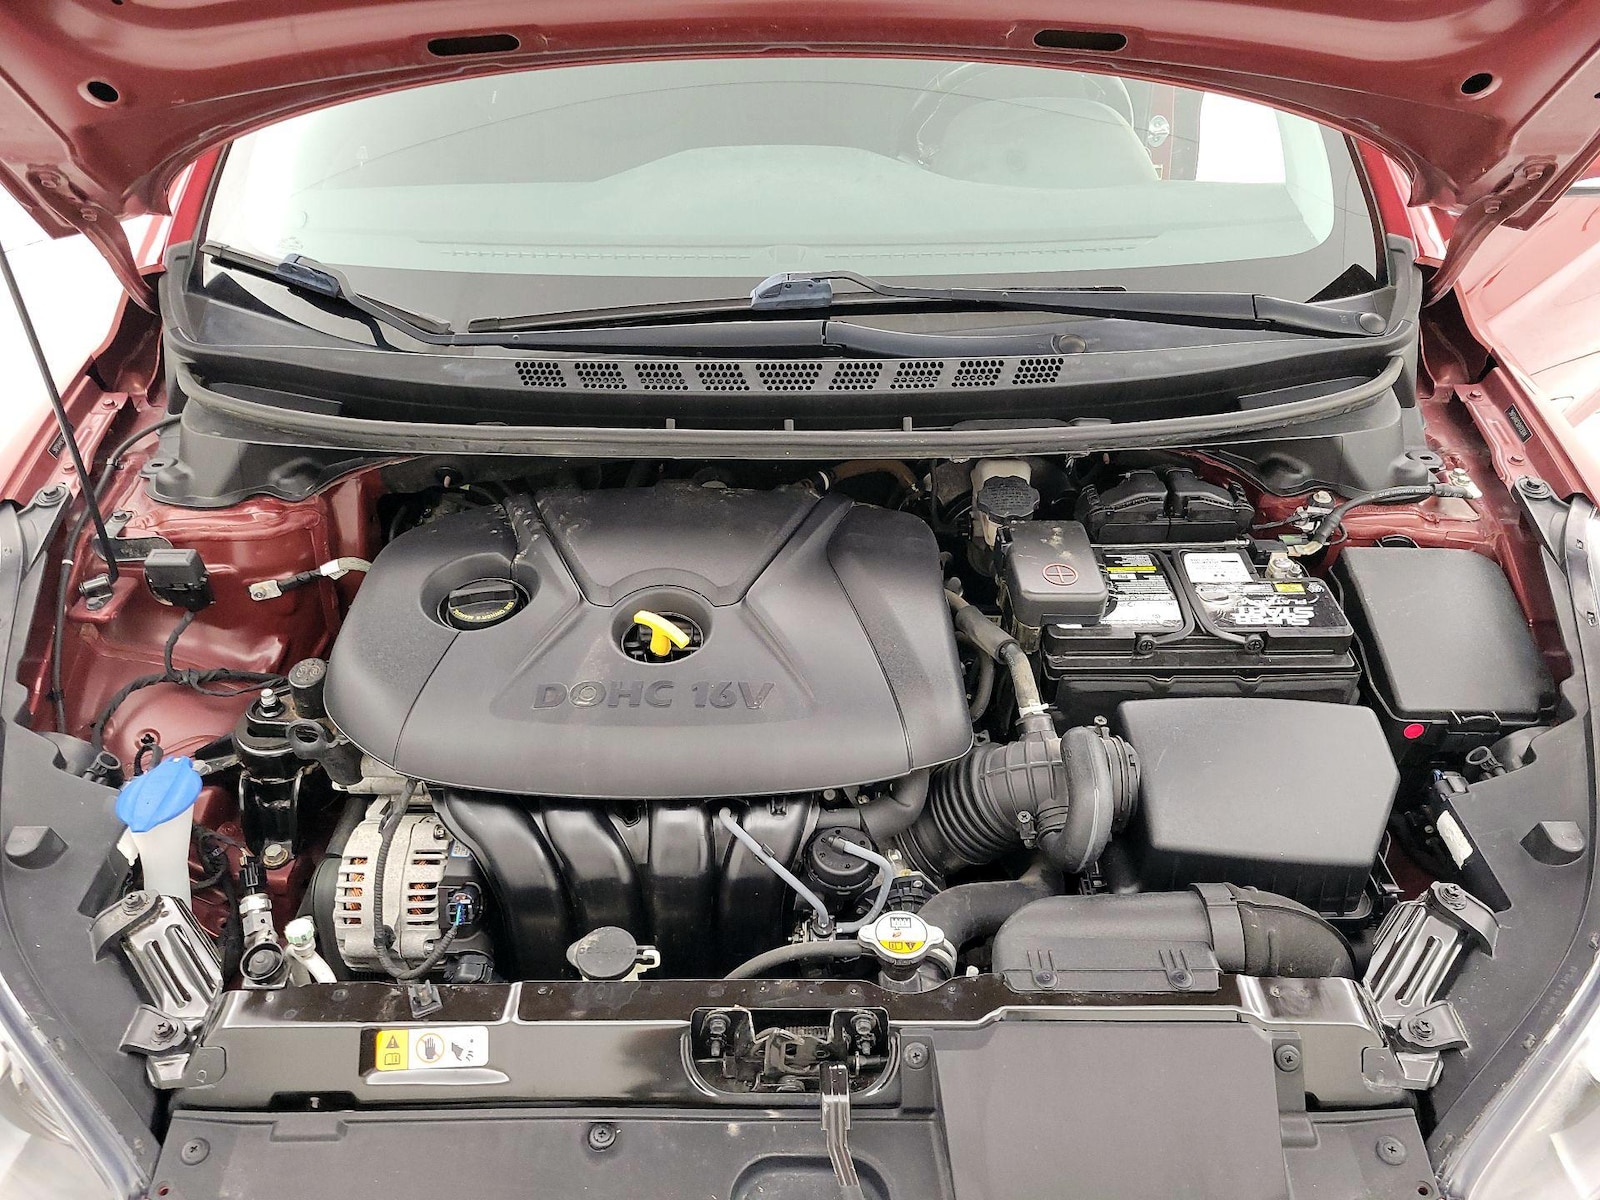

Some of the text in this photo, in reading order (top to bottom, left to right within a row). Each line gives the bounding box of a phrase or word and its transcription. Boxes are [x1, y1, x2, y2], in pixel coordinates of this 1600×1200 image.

[1234, 606, 1315, 618] START
[1235, 616, 1310, 626] SUPER
[533, 680, 776, 710] DOHC 16V
